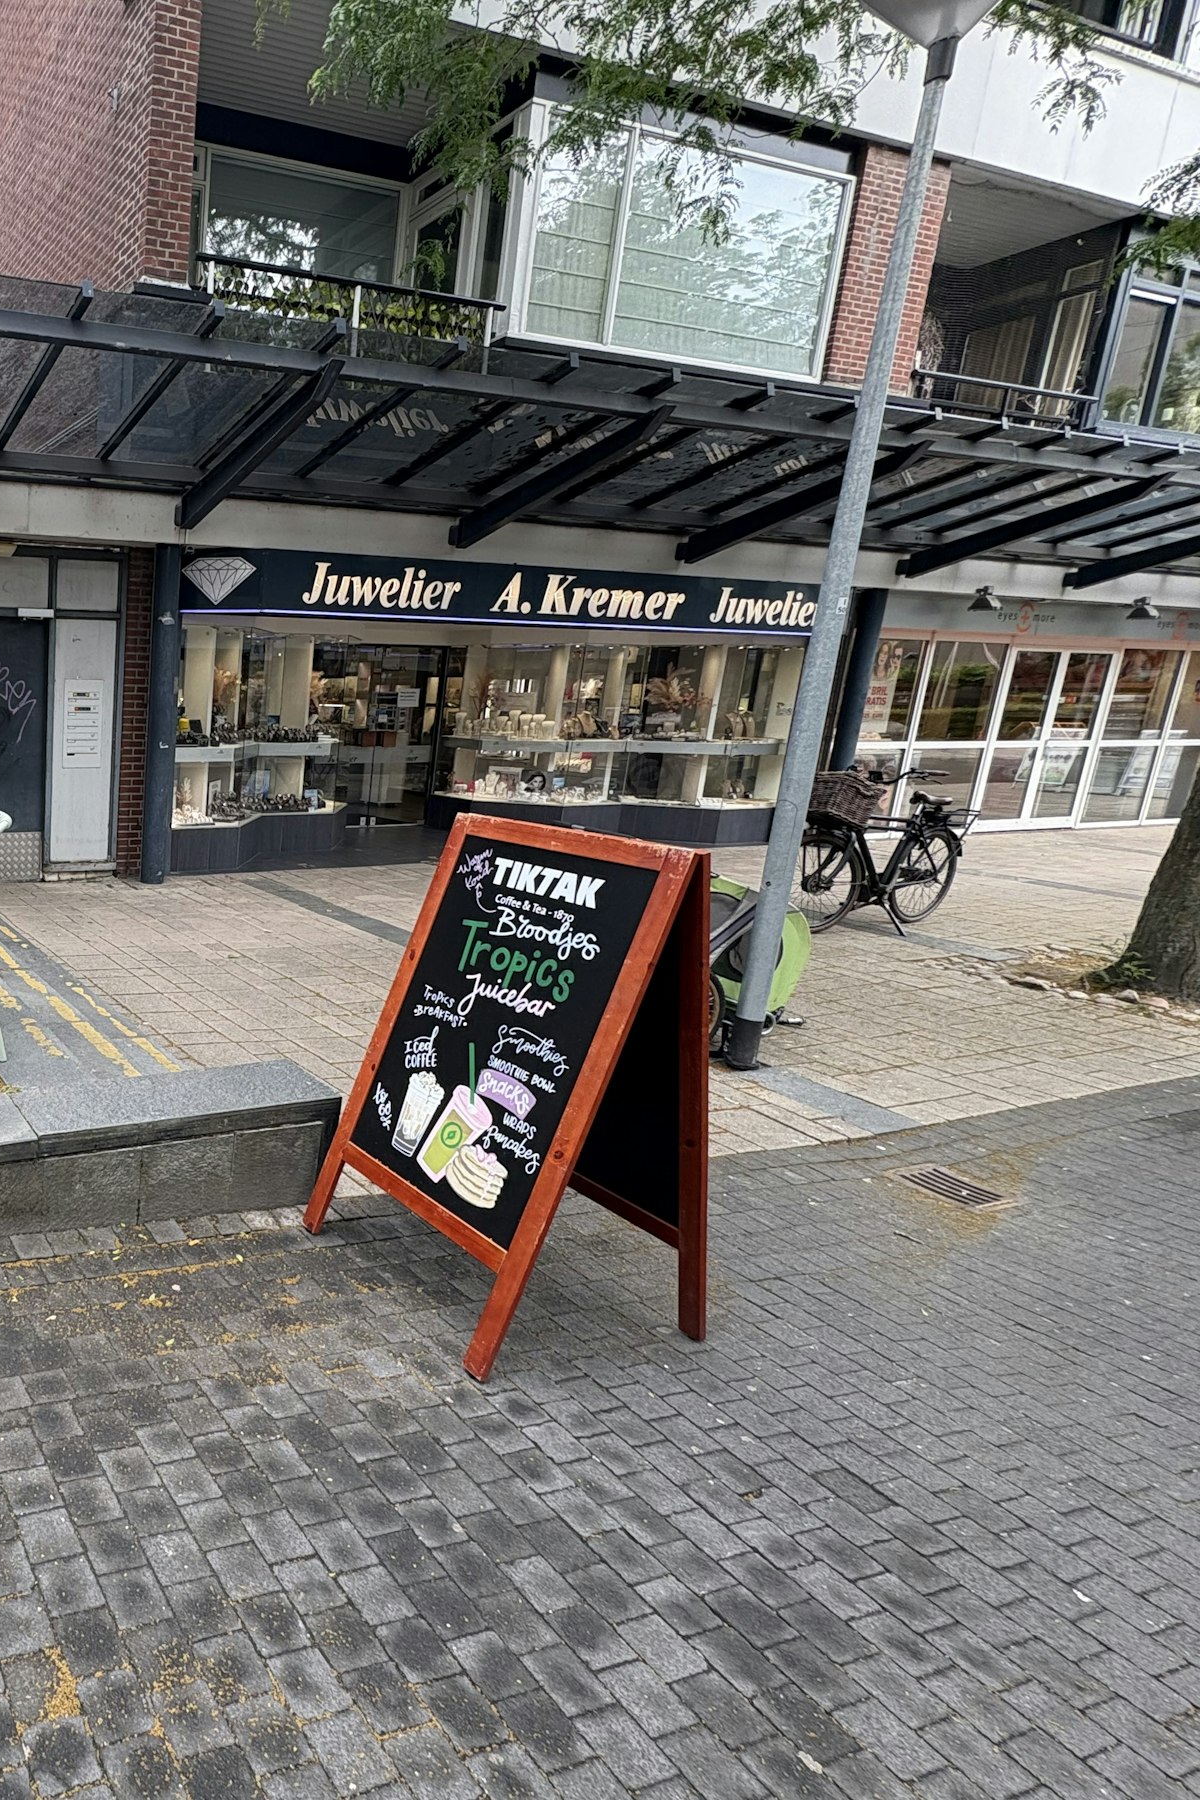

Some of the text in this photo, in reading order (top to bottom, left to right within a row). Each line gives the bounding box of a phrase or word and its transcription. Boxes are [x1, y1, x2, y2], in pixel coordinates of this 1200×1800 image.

[302, 562, 461, 610] Juwelier
[490, 572, 532, 615] A.
[538, 575, 685, 620] Kremer
[492, 856, 606, 909] TIKTAK
[495, 894, 522, 908] Coffee
[522, 901, 531, 911] &
[532, 903, 547, 916] Tea
[553, 910, 575, 923] 1870
[489, 906, 601, 960] Broodjes
[458, 919, 575, 1003] Tropics
[457, 973, 556, 1018] Juicebar
[404, 1025, 440, 1055] Iced
[404, 1052, 438, 1069] COFFEE
[492, 1025, 570, 1077] Smoothies
[531, 1074, 557, 1094] BOWL
[503, 1112, 537, 1139] WRAPS
